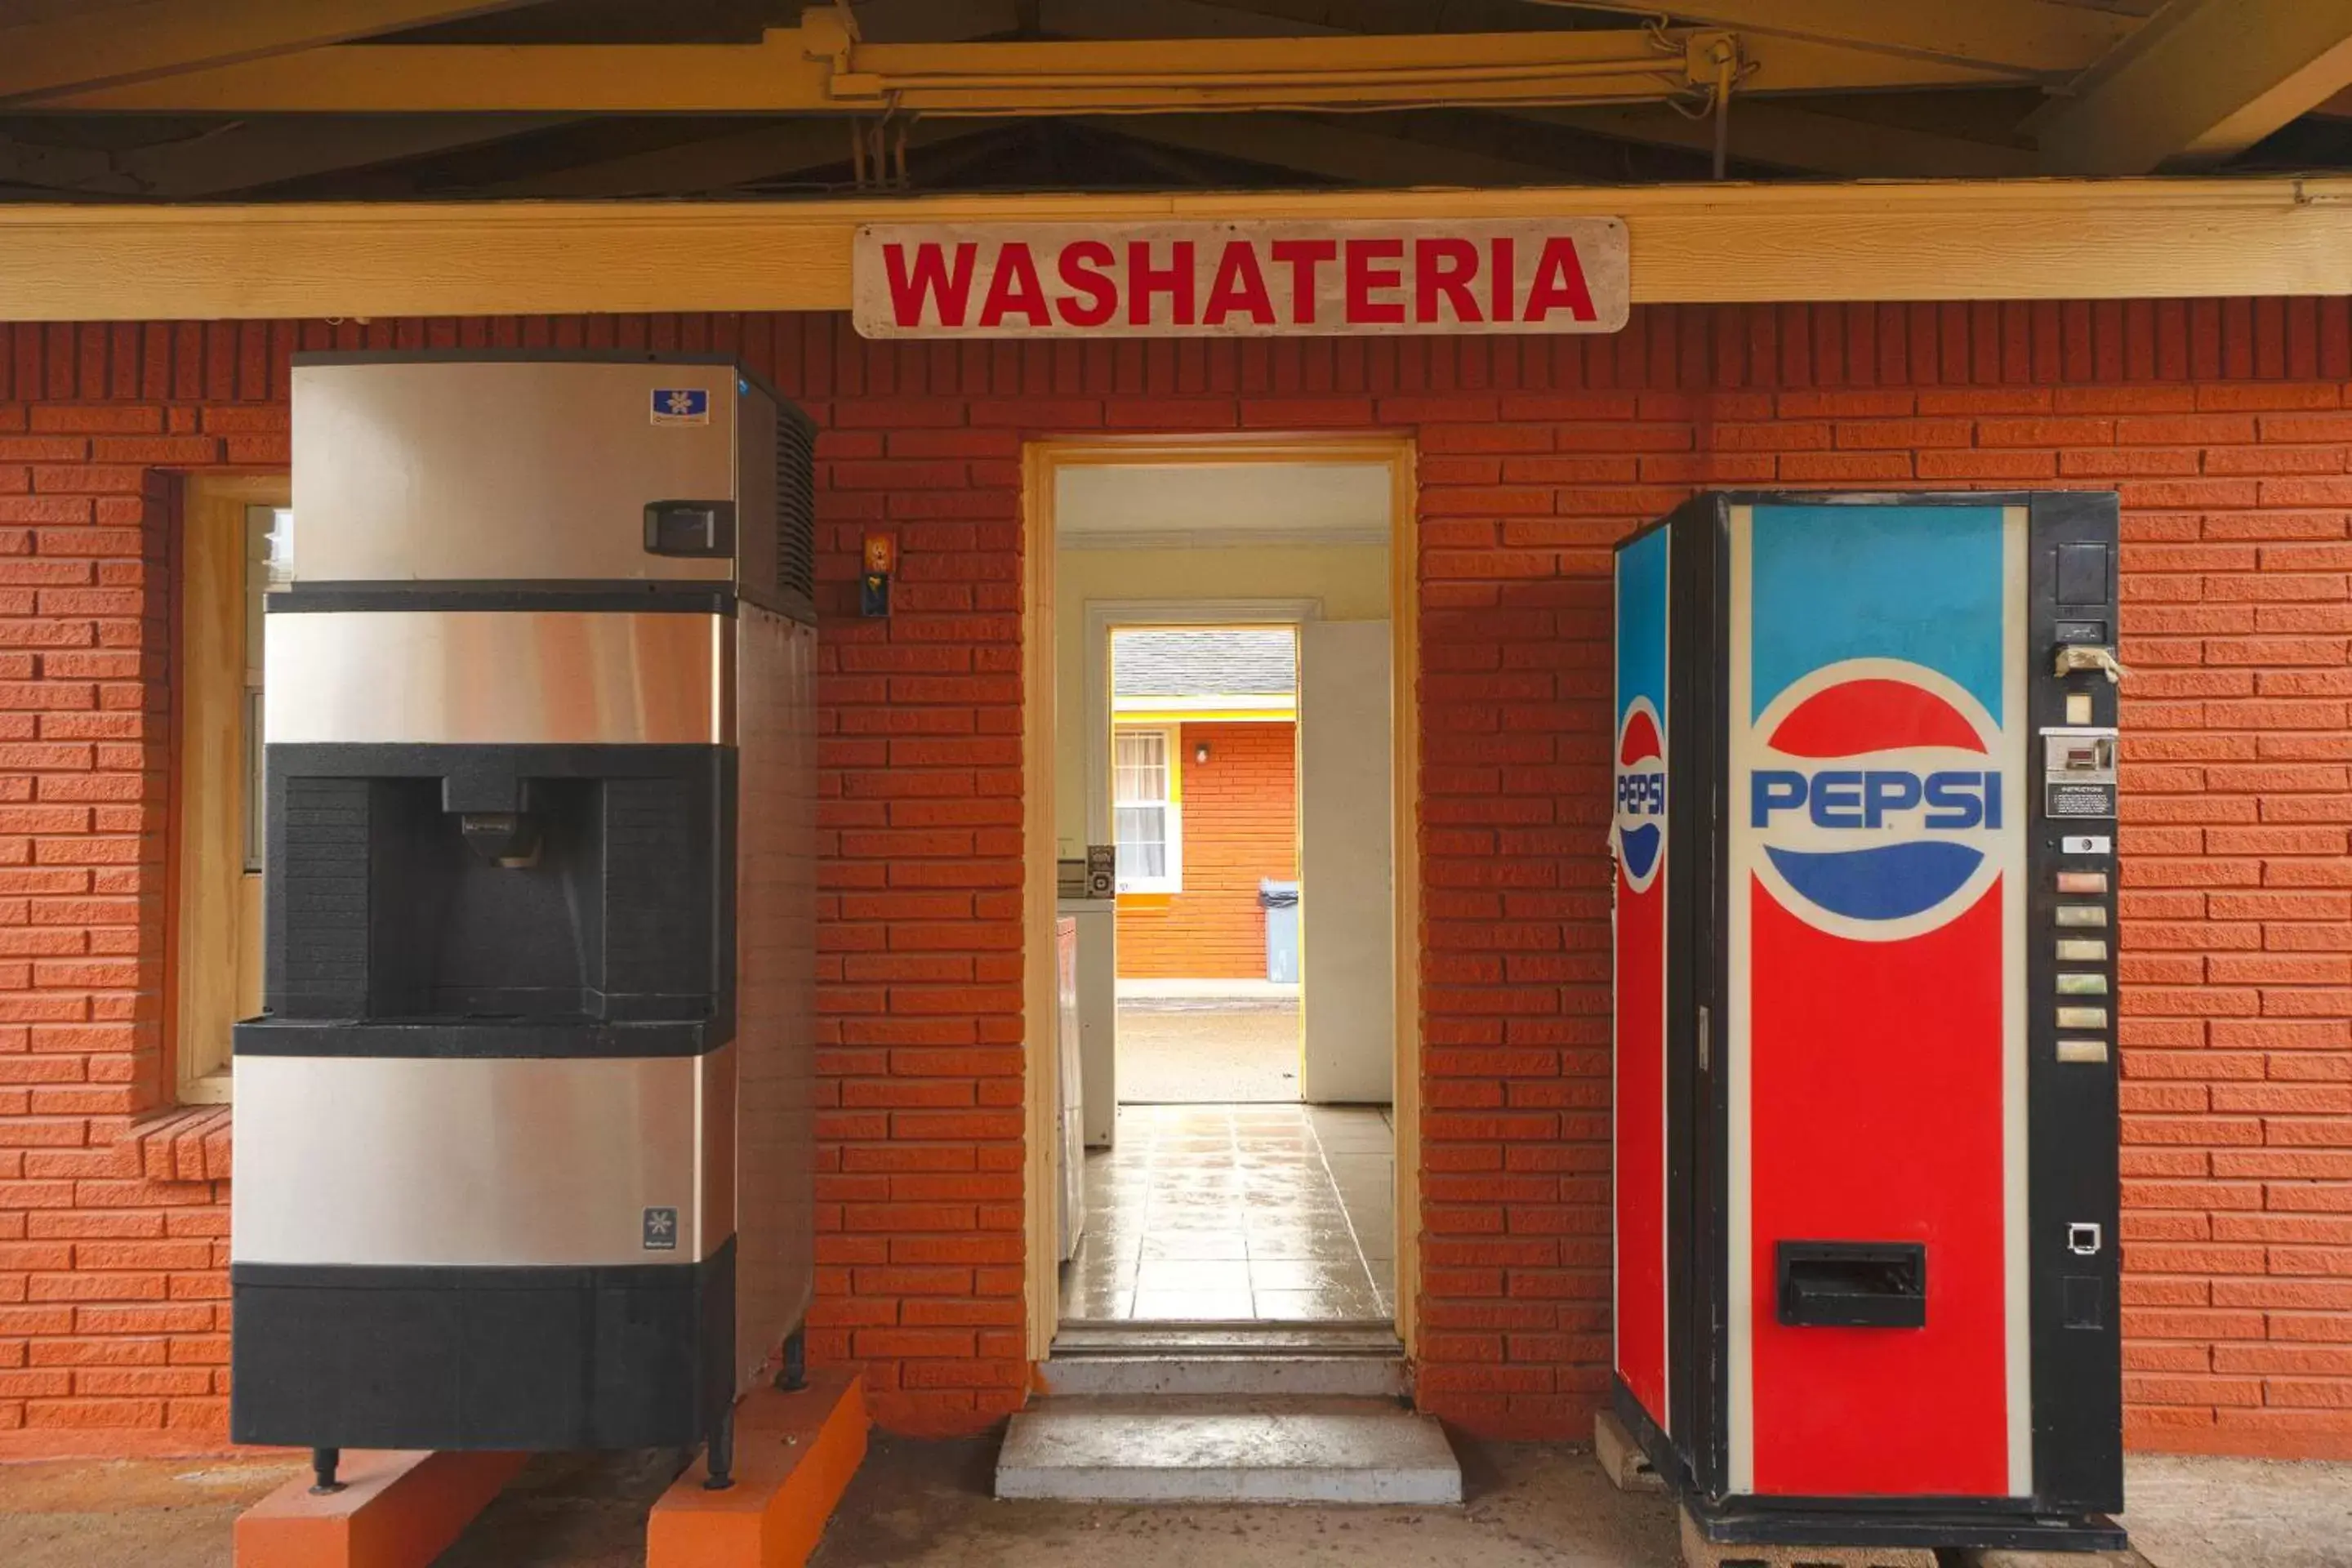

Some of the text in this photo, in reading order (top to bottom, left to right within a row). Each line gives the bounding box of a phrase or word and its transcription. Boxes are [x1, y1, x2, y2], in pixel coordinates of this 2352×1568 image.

[882, 237, 1598, 327] WASHATERIA
[1618, 773, 1664, 815] PEPSI
[1750, 770, 2002, 830] PEPSI
